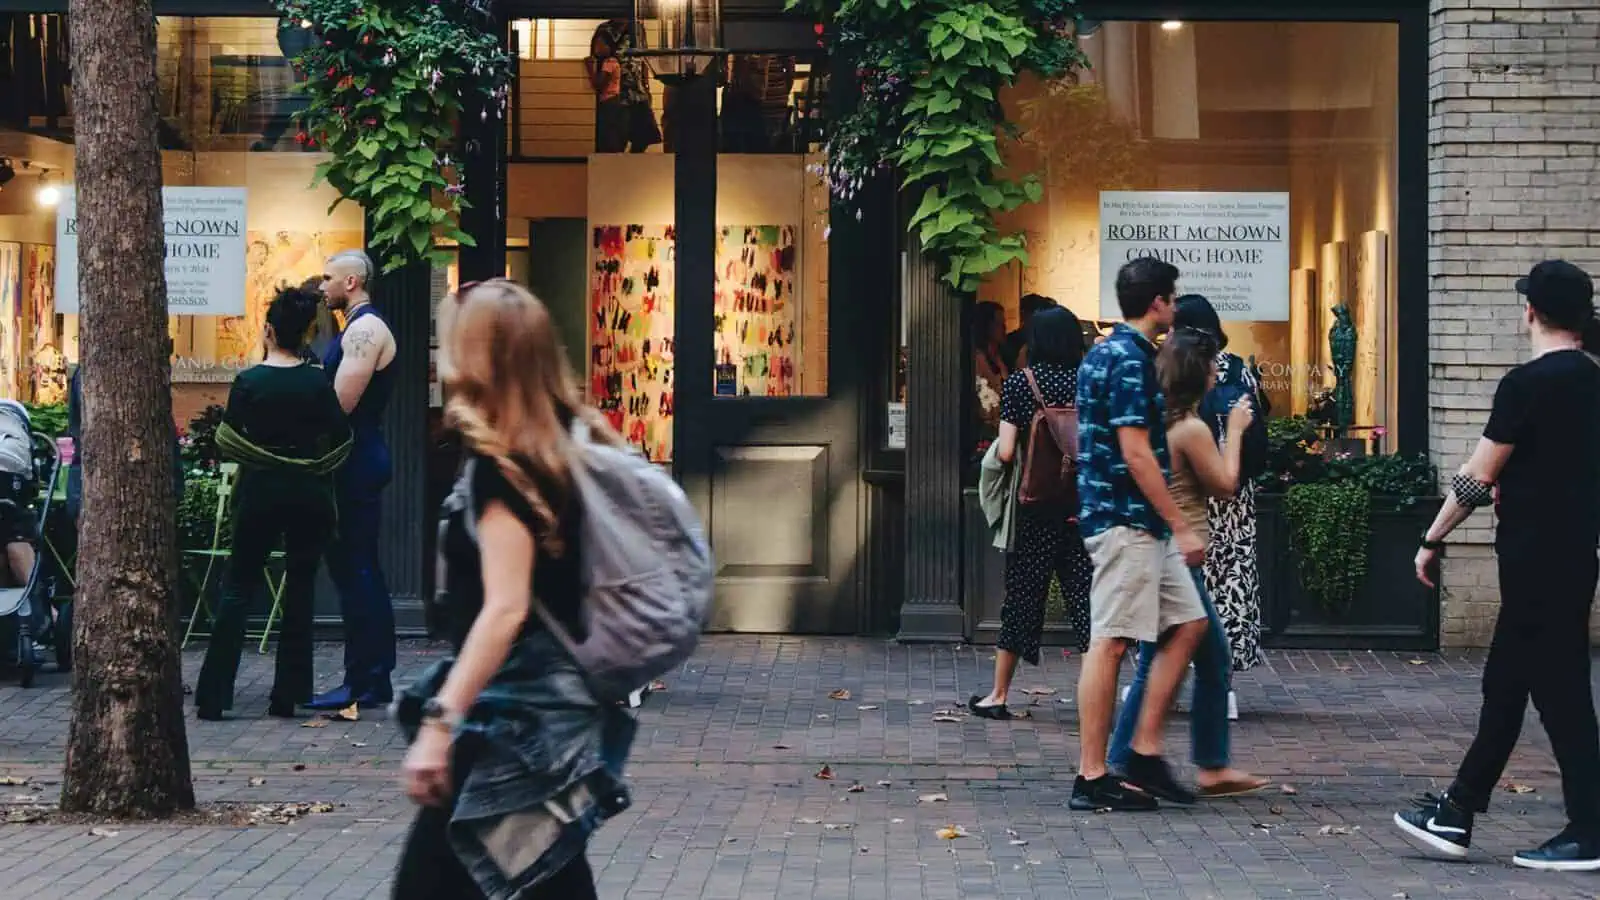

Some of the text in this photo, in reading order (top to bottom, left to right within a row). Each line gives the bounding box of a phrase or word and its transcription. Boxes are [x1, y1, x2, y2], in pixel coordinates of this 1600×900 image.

[164, 218, 239, 236] CNOWN
[1107, 223, 1281, 241] ROBERT MCNOWN
[163, 242, 220, 259] HOME
[1126, 247, 1263, 264] COMING HOME
[1179, 269, 1223, 278] EPTEMBER
[168, 295, 209, 306] OHNSON
[1213, 303, 1252, 312] OHNSON
[175, 355, 216, 370] AND
[1256, 360, 1346, 377] COMPAY
